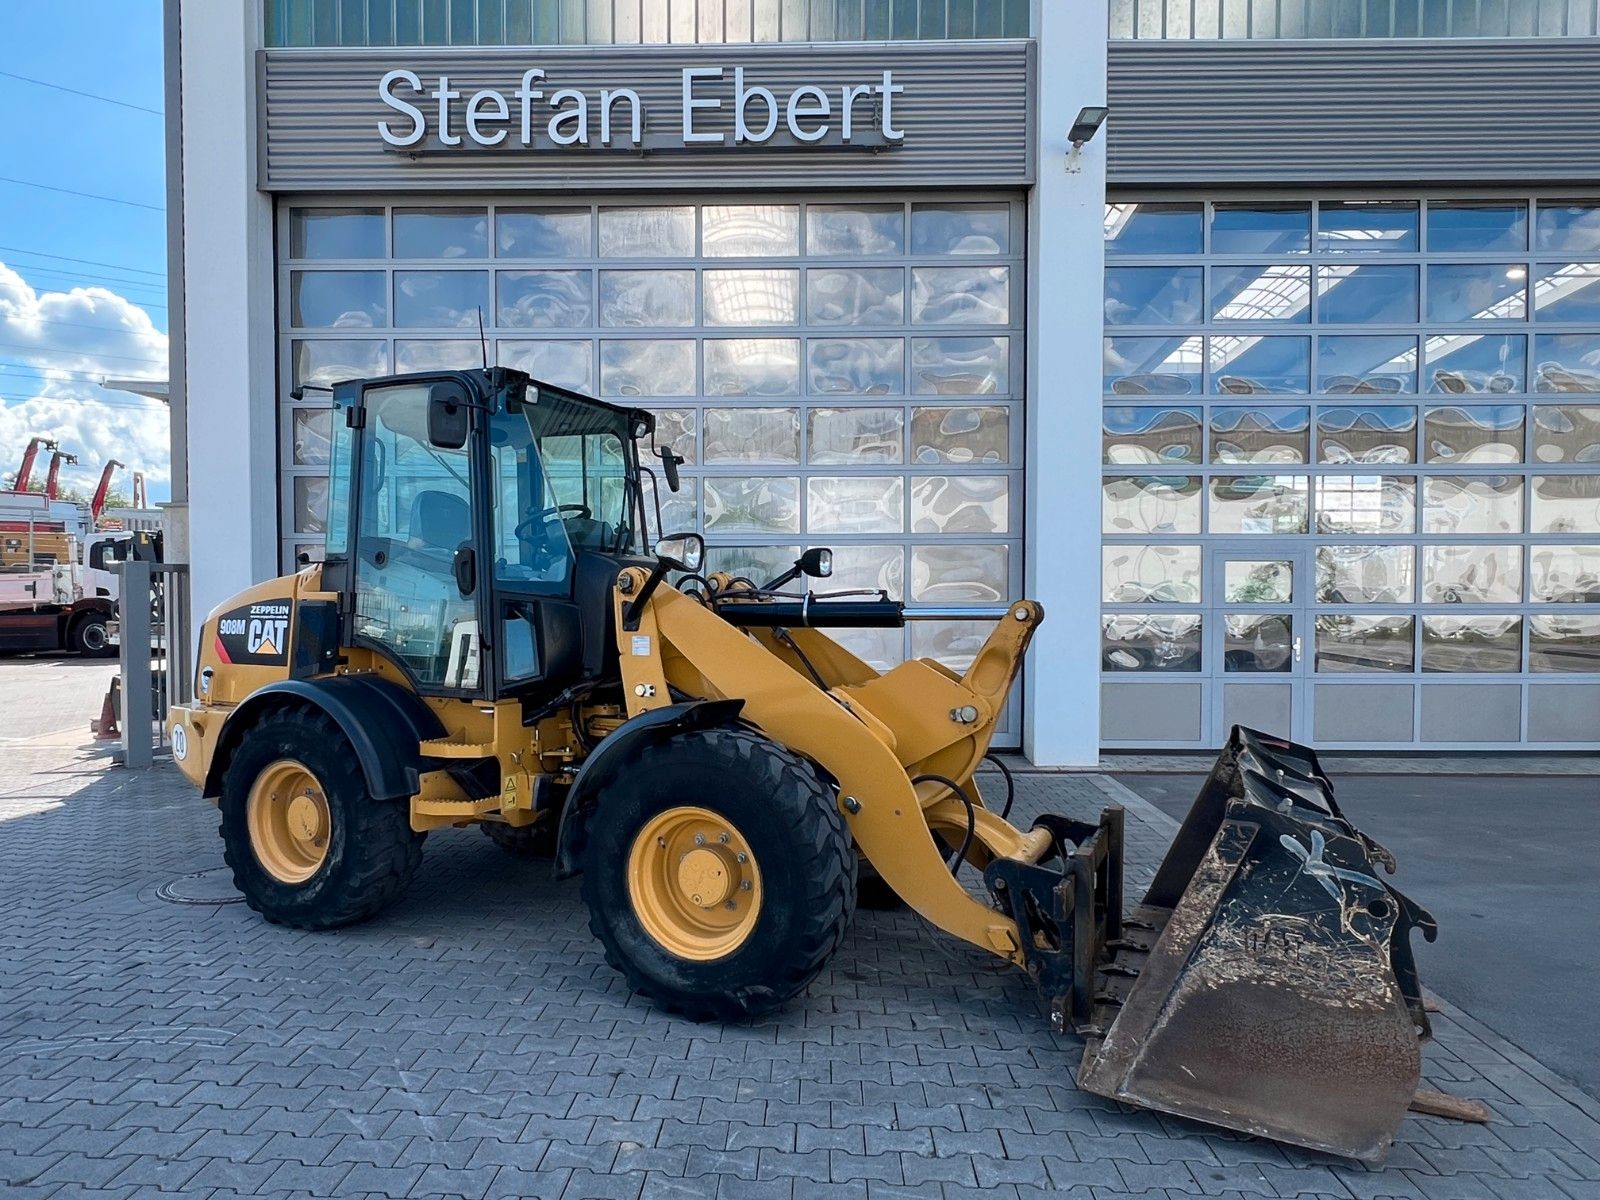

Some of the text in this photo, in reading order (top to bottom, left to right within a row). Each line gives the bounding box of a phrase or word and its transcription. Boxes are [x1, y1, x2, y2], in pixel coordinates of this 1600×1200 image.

[377, 66, 904, 146] Stefan Ebert
[250, 605, 289, 615] ZEPPELIN
[220, 619, 246, 635] 908M
[248, 619, 288, 655] CAT
